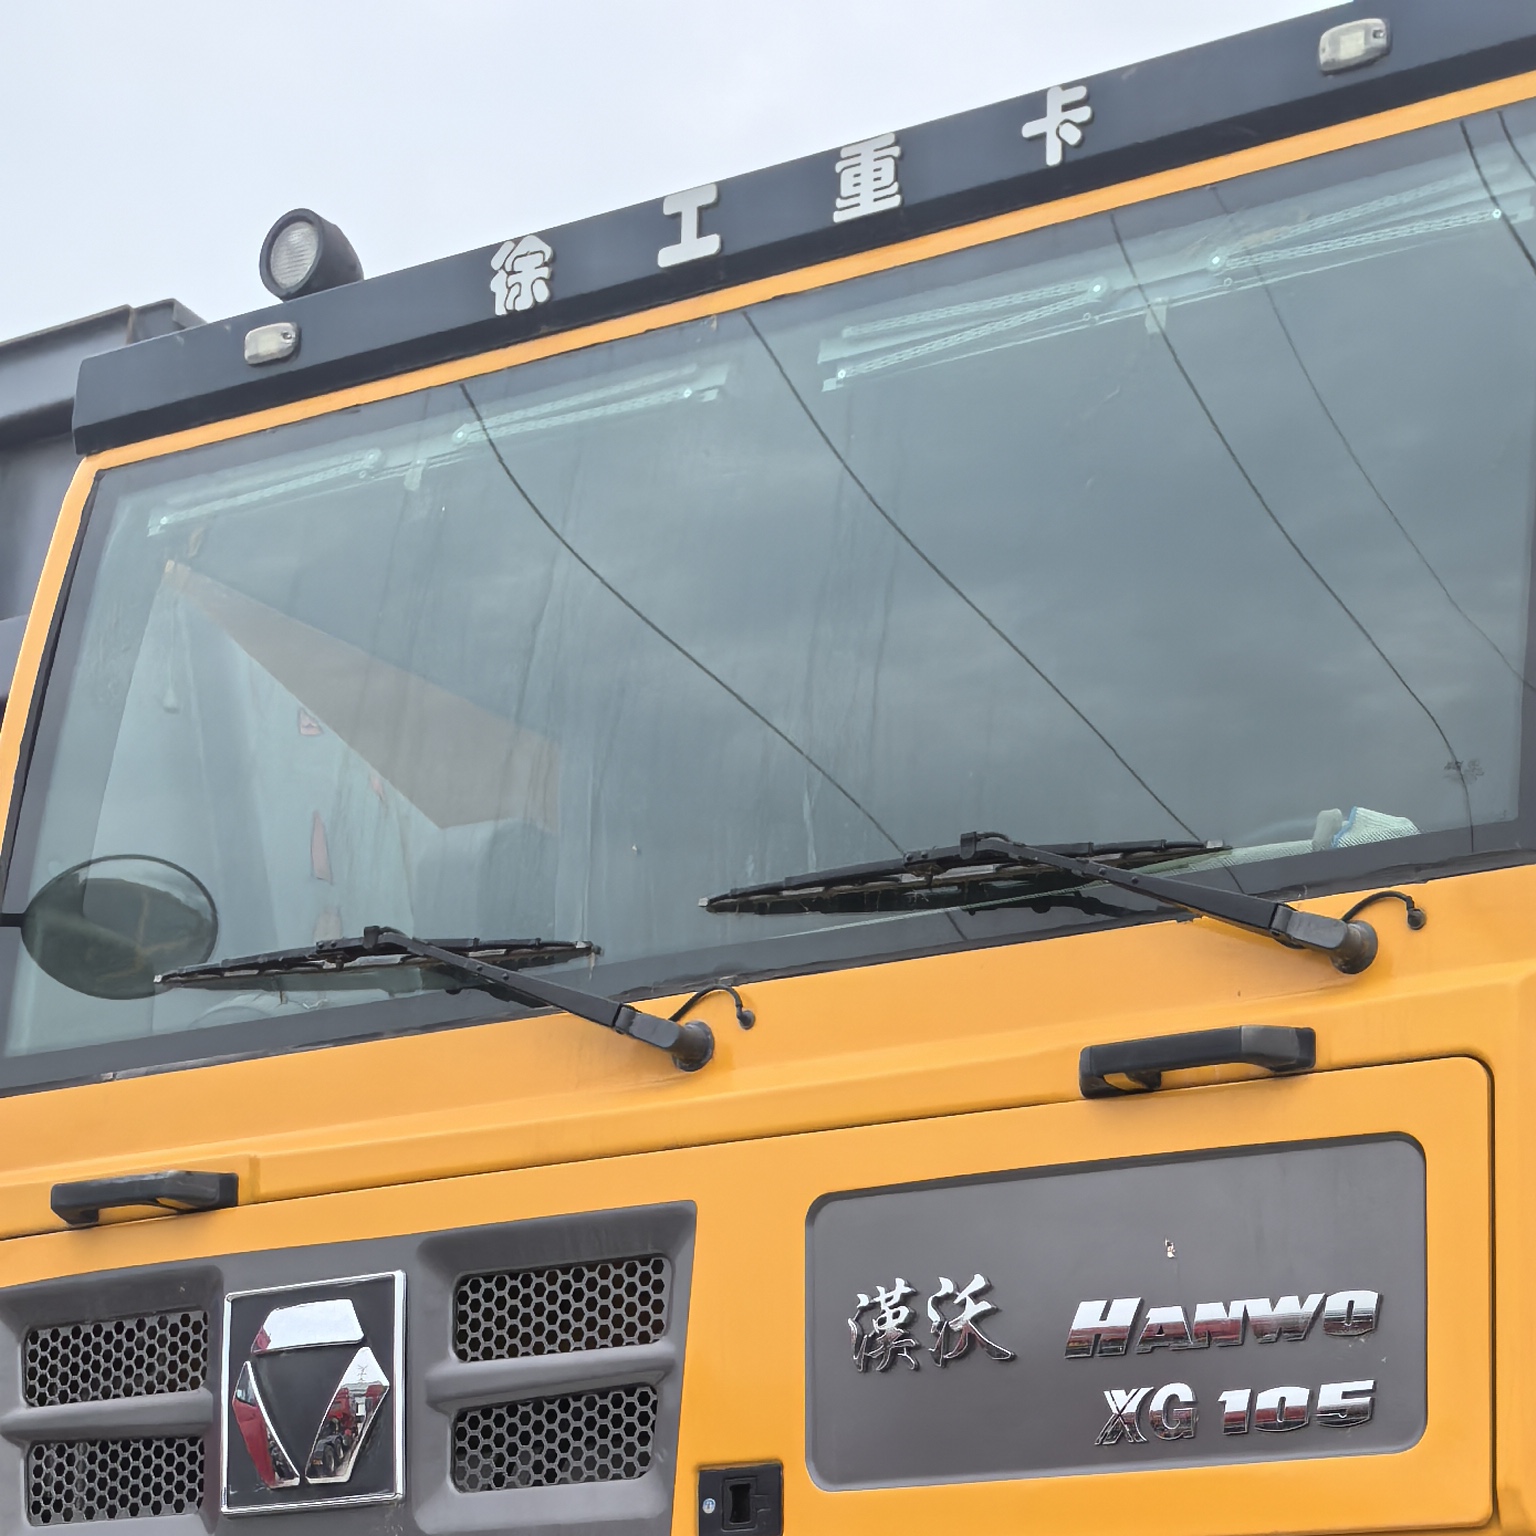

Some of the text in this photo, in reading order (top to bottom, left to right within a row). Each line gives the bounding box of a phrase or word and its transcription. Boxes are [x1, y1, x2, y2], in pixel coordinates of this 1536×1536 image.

[491, 86, 1092, 316] 徐工重卡
[1064, 1289, 1383, 1360] HANWO
[1094, 1379, 1377, 1446] XG 105
